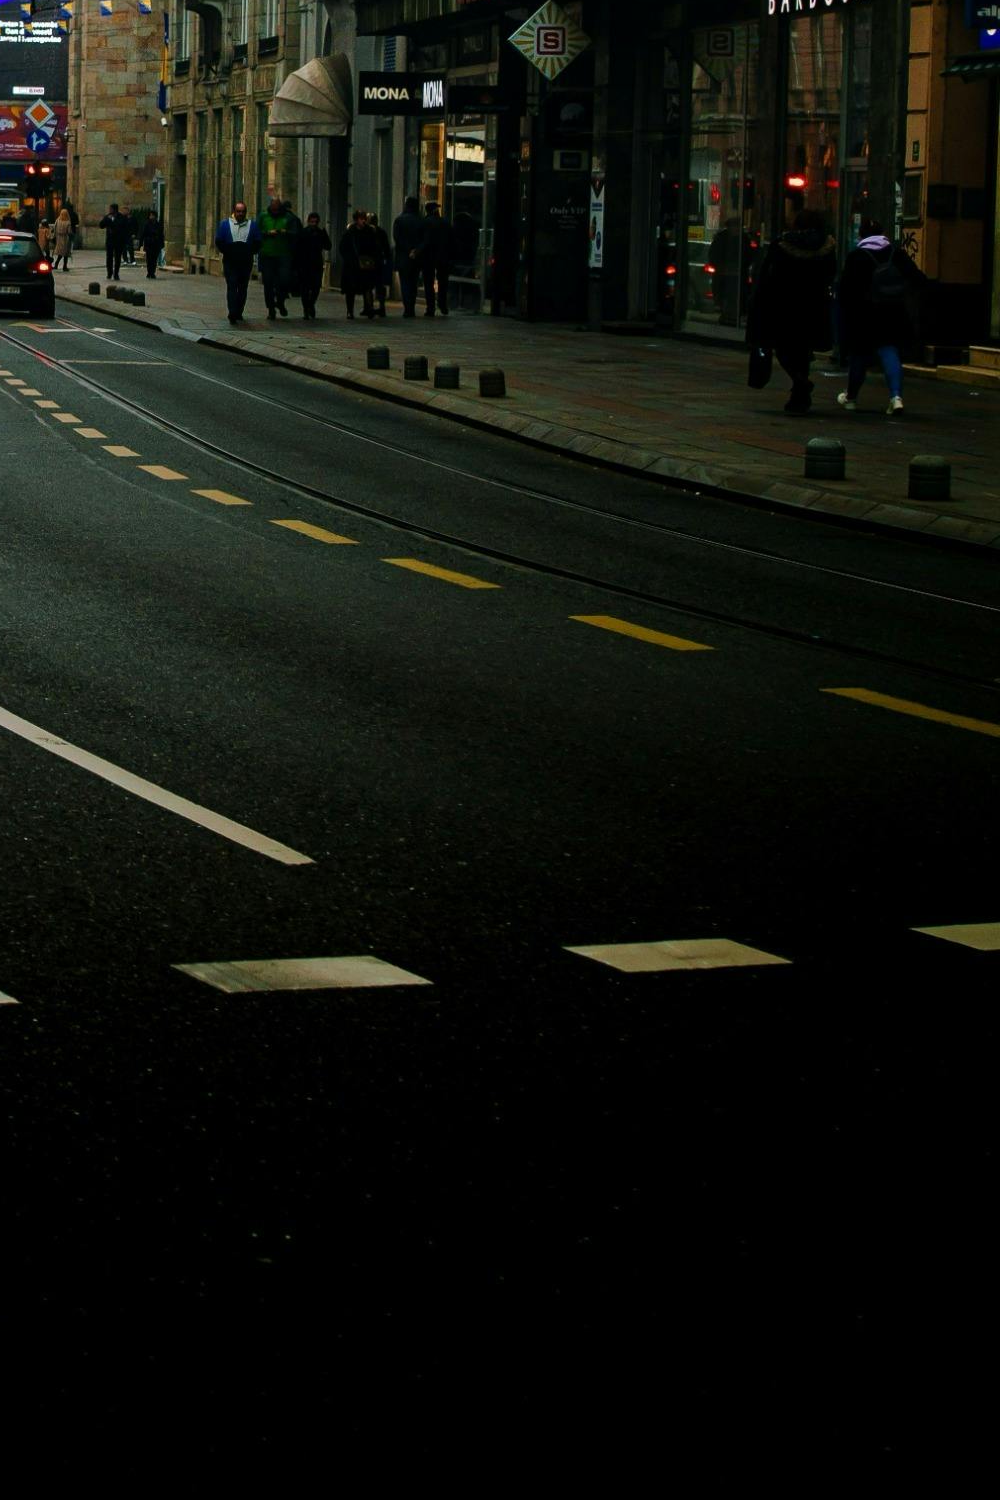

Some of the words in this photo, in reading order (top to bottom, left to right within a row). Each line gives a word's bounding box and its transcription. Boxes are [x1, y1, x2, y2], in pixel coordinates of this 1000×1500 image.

[543, 31, 560, 50] S
[363, 86, 410, 101] MONA
[422, 80, 444, 108] MONA
